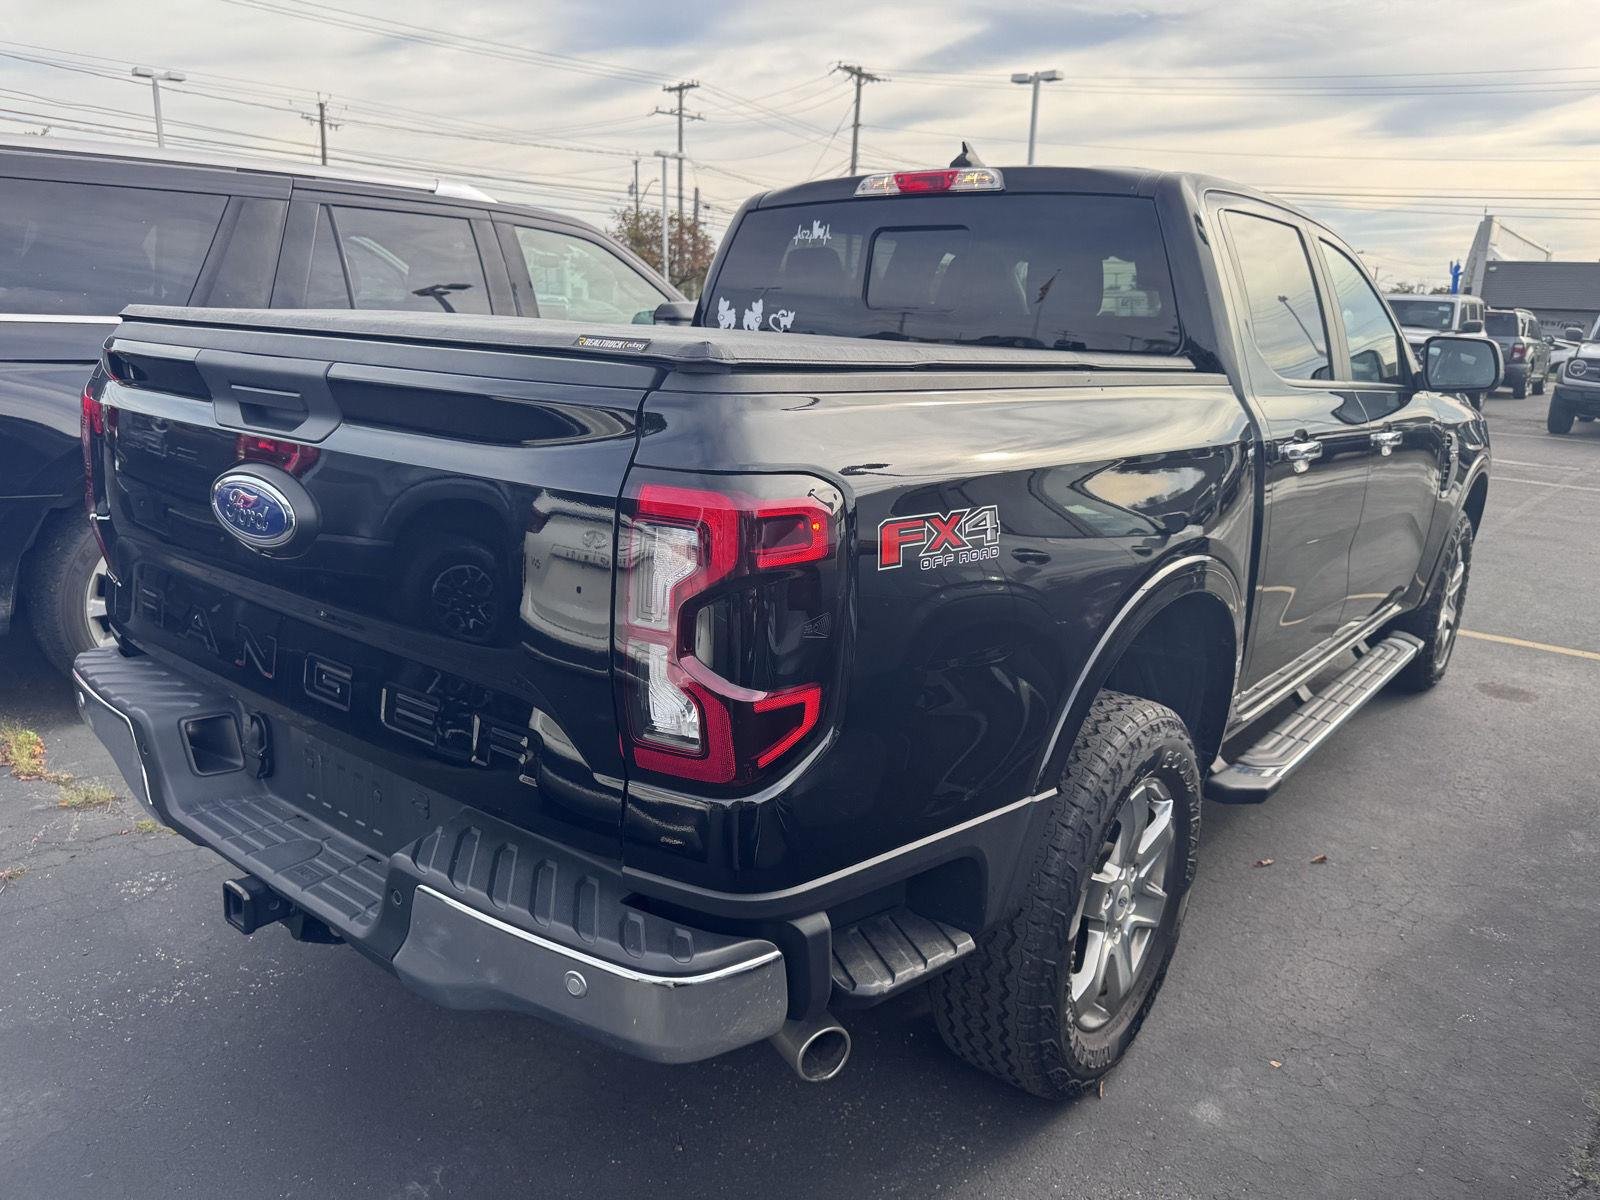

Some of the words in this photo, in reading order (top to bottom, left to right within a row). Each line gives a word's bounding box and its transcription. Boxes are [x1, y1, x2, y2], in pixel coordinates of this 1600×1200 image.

[585, 338, 625, 349] REALTRUCK
[225, 488, 269, 531] Ford
[877, 504, 1001, 571] FX4
[920, 553, 954, 571] OFF
[958, 545, 1000, 564] ROAD
[138, 584, 542, 787] RANGER
